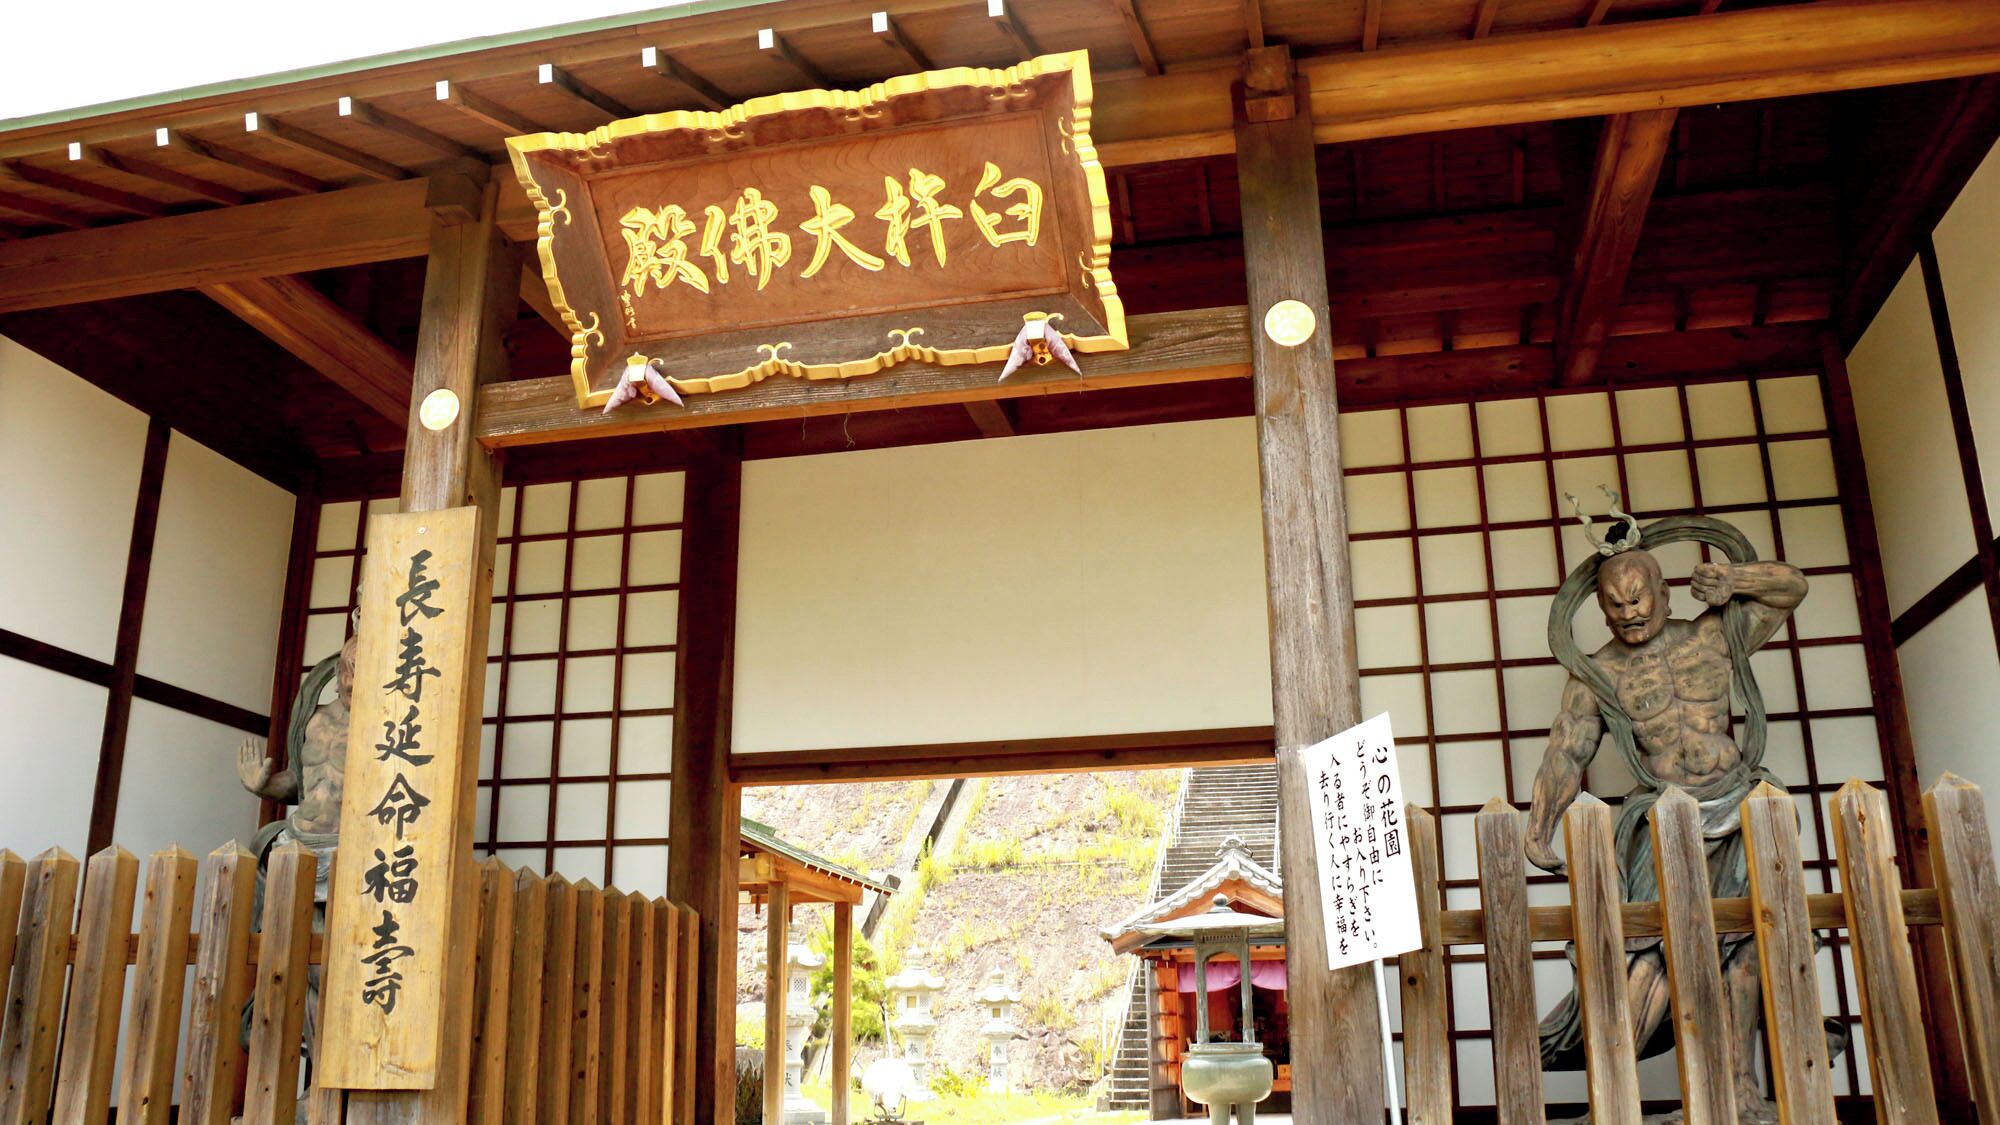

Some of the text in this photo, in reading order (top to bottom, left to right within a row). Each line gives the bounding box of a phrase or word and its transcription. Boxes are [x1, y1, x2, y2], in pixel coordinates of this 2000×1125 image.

[1319, 770, 1349, 955] 去り行く人に幸福を
[1330, 754, 1360, 937] 入る者にやすらぎを
[1356, 739, 1384, 885] どうぞ御自由に
[1372, 746, 1401, 858] 心の花園
